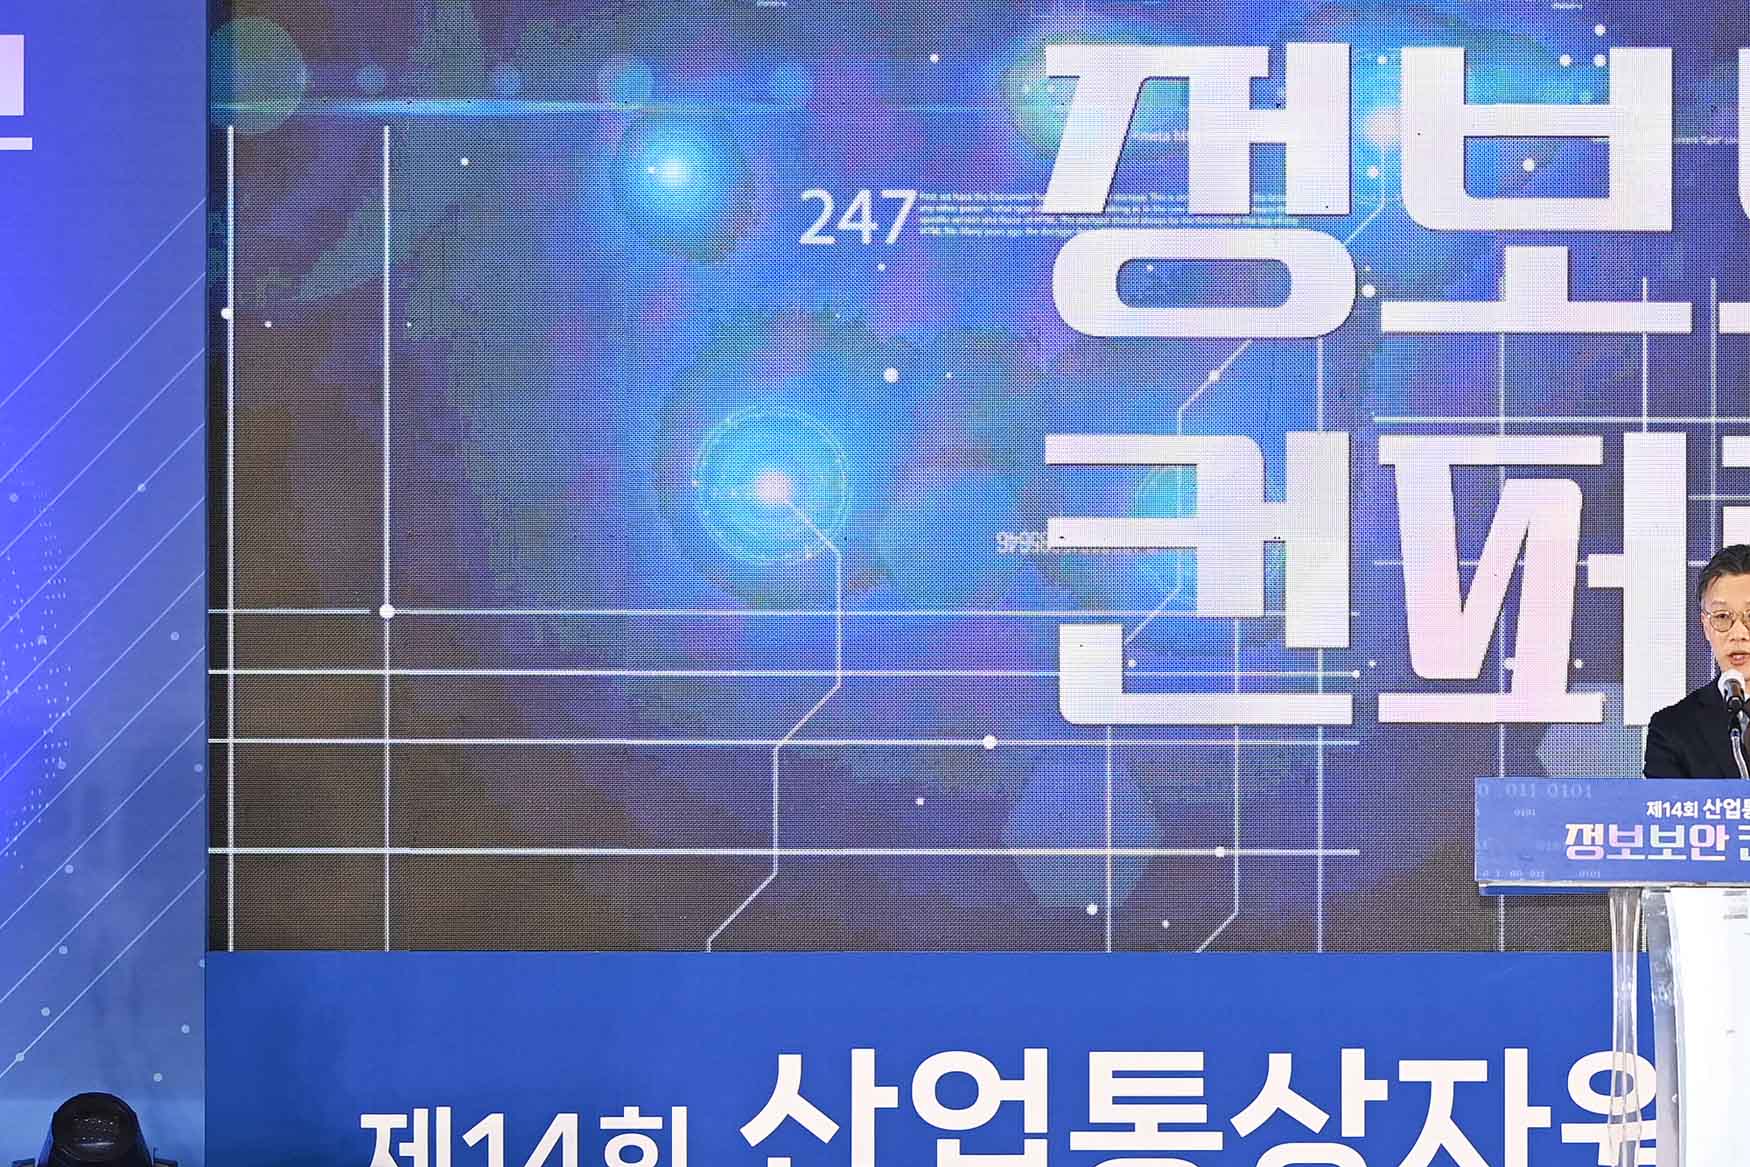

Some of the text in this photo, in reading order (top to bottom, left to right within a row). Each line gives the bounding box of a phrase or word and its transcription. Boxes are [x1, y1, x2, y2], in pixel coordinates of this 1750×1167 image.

[799, 189, 917, 245] 247
[1646, 800, 1699, 818] 제14회
[1564, 823, 1730, 861] 정보보안
